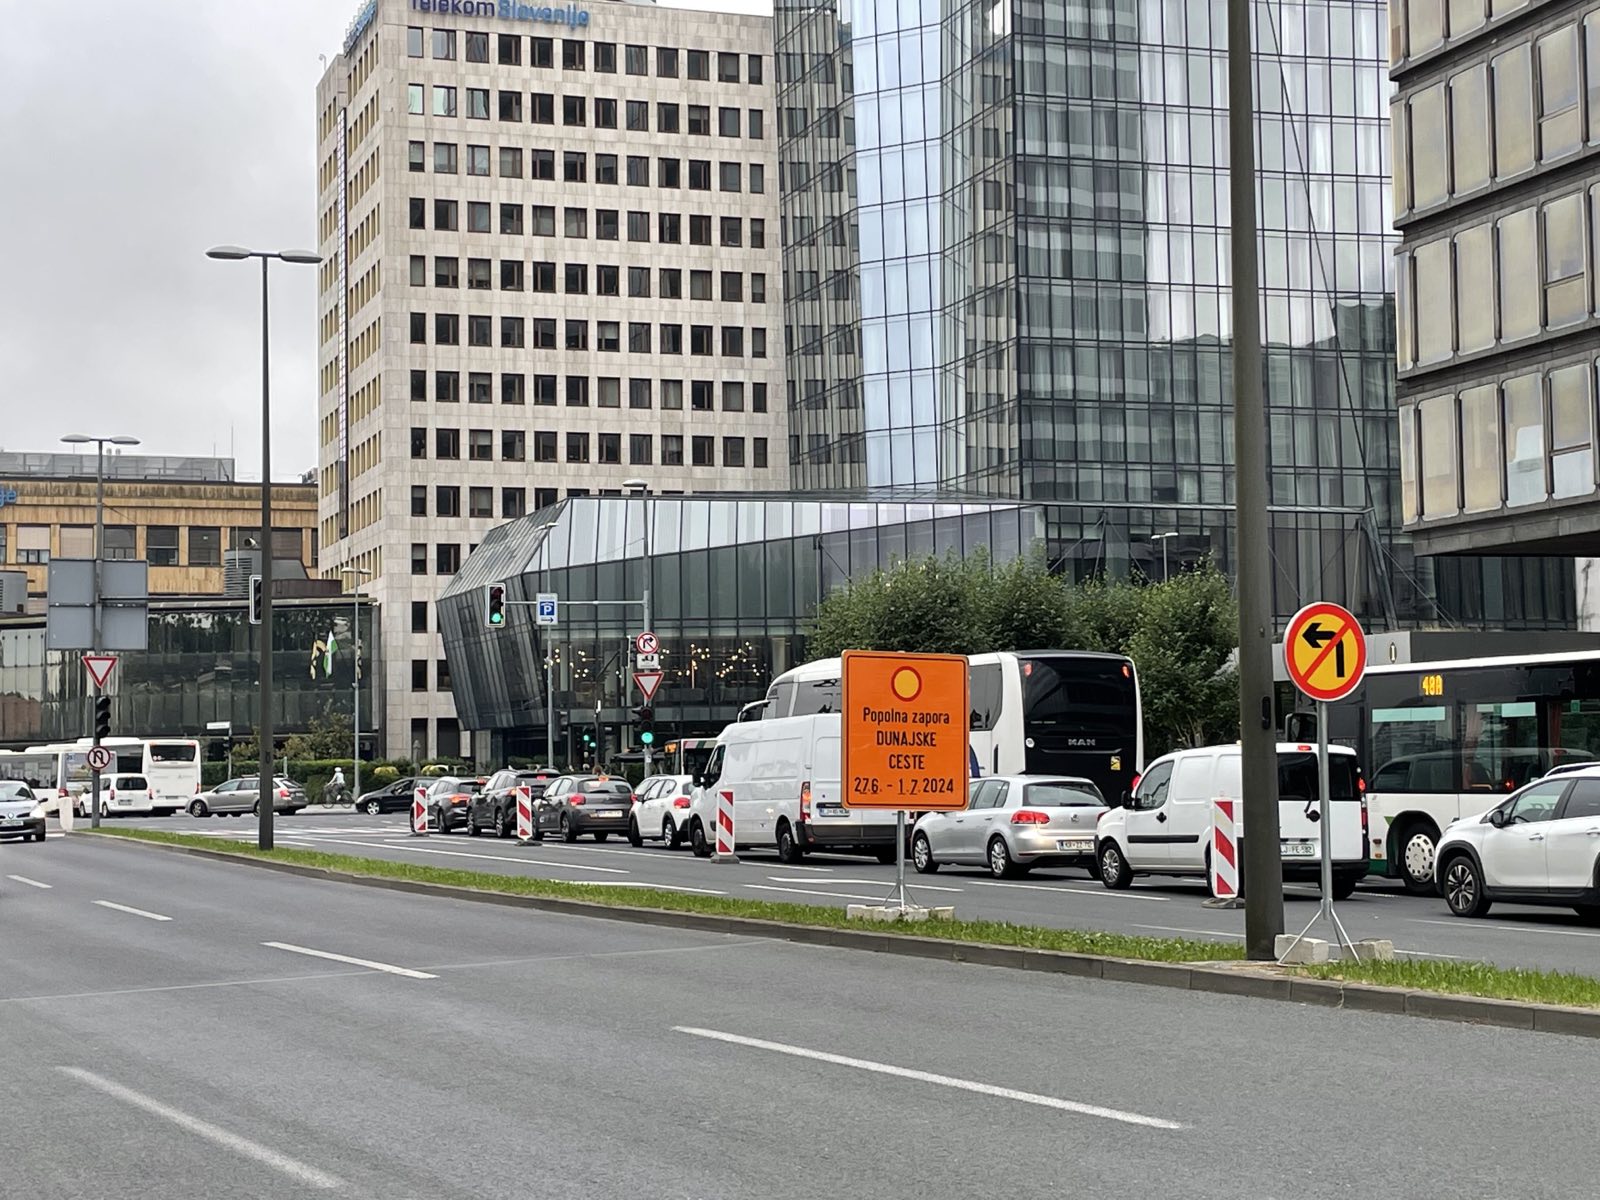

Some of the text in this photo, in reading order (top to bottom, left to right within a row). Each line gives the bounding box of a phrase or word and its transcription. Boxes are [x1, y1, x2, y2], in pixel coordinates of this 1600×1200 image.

[498, 0, 590, 29] Slovenije
[863, 706, 950, 727] Popolna zapora
[876, 730, 937, 747] DUNAJSKE
[1067, 738, 1096, 746] MAN
[888, 753, 926, 770] CESTE
